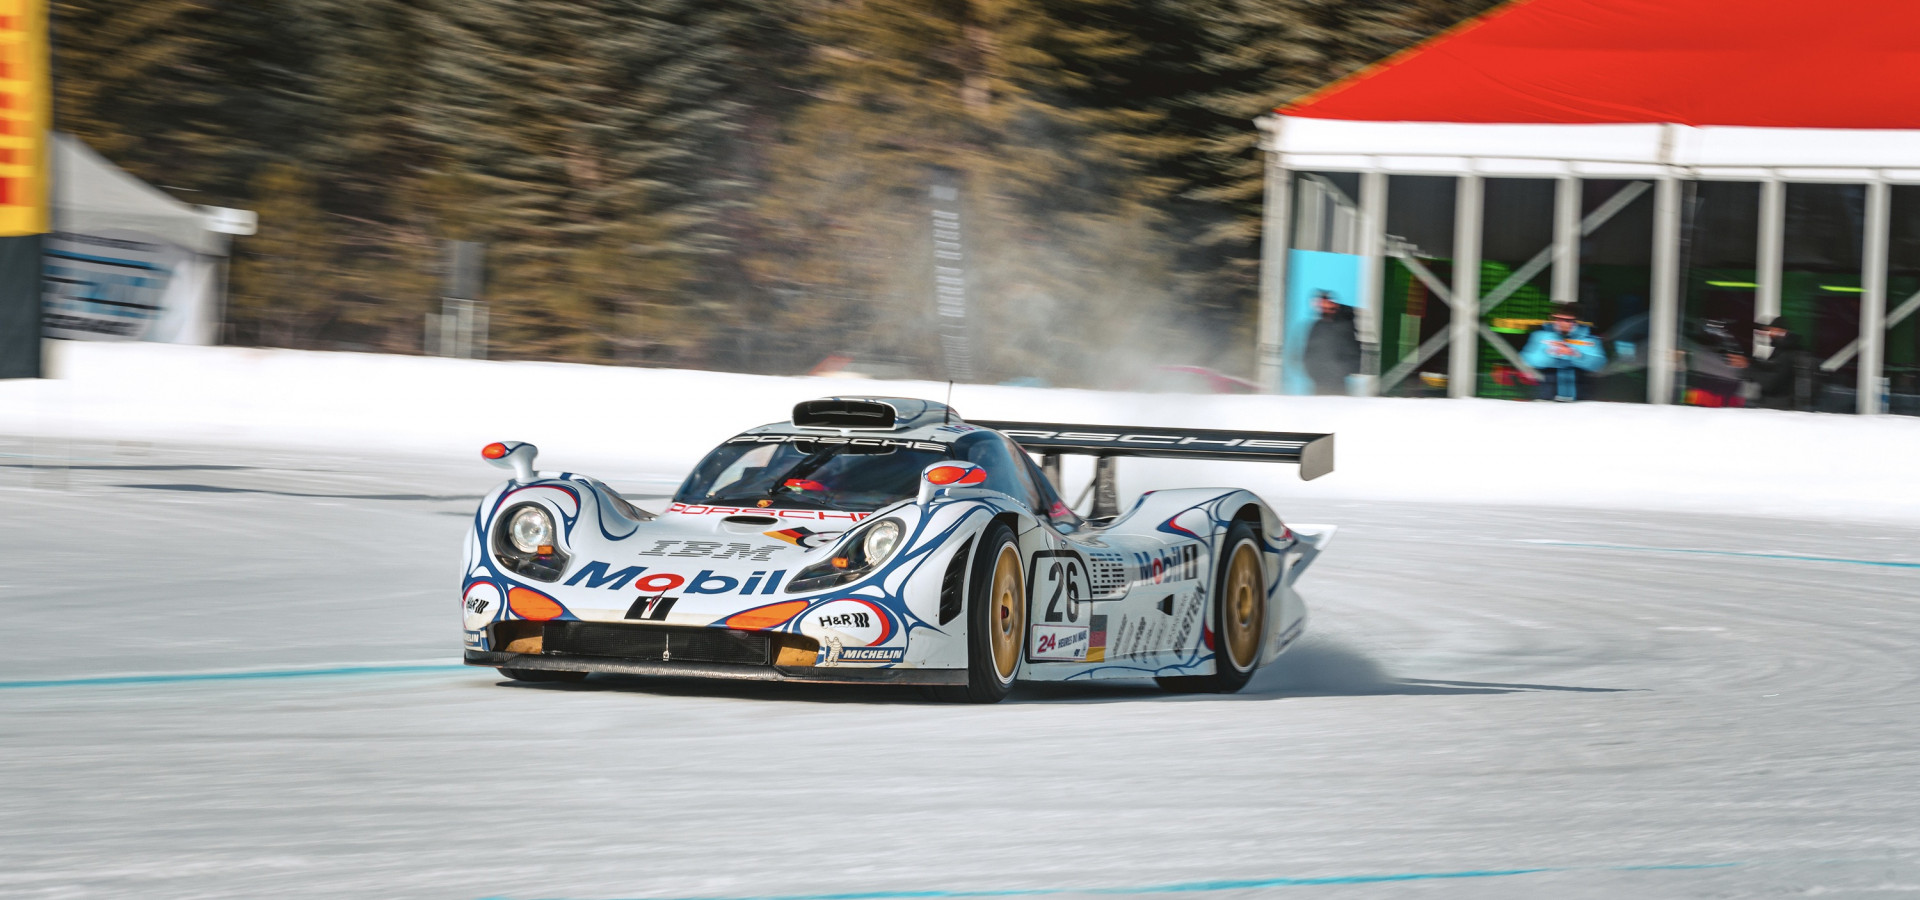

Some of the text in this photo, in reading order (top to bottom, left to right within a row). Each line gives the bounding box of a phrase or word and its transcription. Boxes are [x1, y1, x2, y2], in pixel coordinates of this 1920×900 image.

[728, 434, 946, 452] PORSCHE
[999, 429, 1309, 449] RSCHE
[639, 540, 787, 561] IBM
[1133, 546, 1181, 586] Mobil
[563, 560, 787, 595] Mobil
[1045, 562, 1079, 623] 26
[819, 614, 852, 627] H&R
[1037, 633, 1056, 653] 24
[843, 650, 902, 659] MICHELIN
